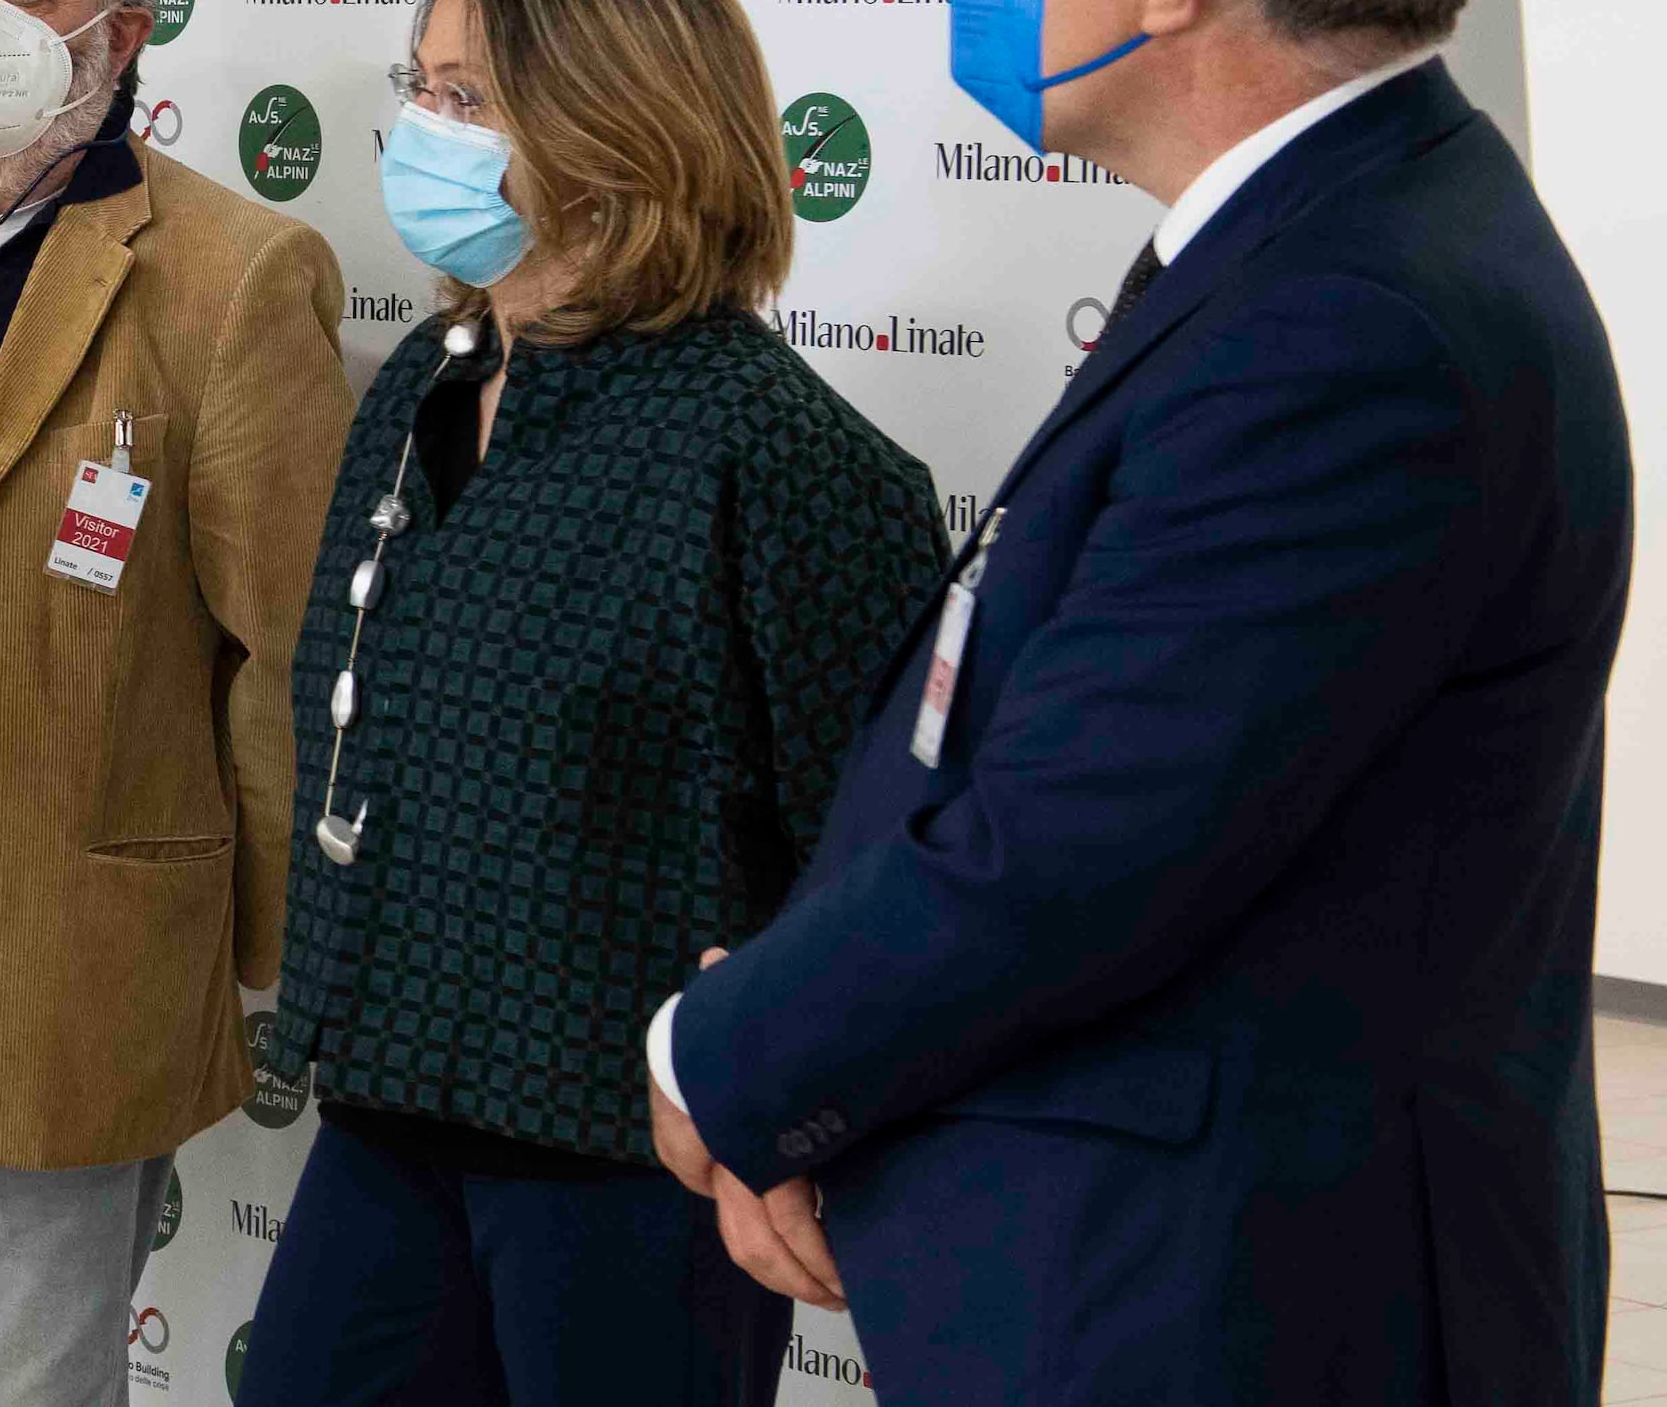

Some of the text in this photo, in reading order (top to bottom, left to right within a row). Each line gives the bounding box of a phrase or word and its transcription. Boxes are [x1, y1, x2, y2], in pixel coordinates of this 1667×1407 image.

[267, 166, 309, 181] ALPINI
[803, 182, 855, 199] ALPINI
[75, 513, 120, 539] Visitor
[72, 531, 108, 554] 2021
[54, 556, 78, 571] Linate
[256, 1091, 298, 1111] ALPINI
[136, 1362, 170, 1380] Building
